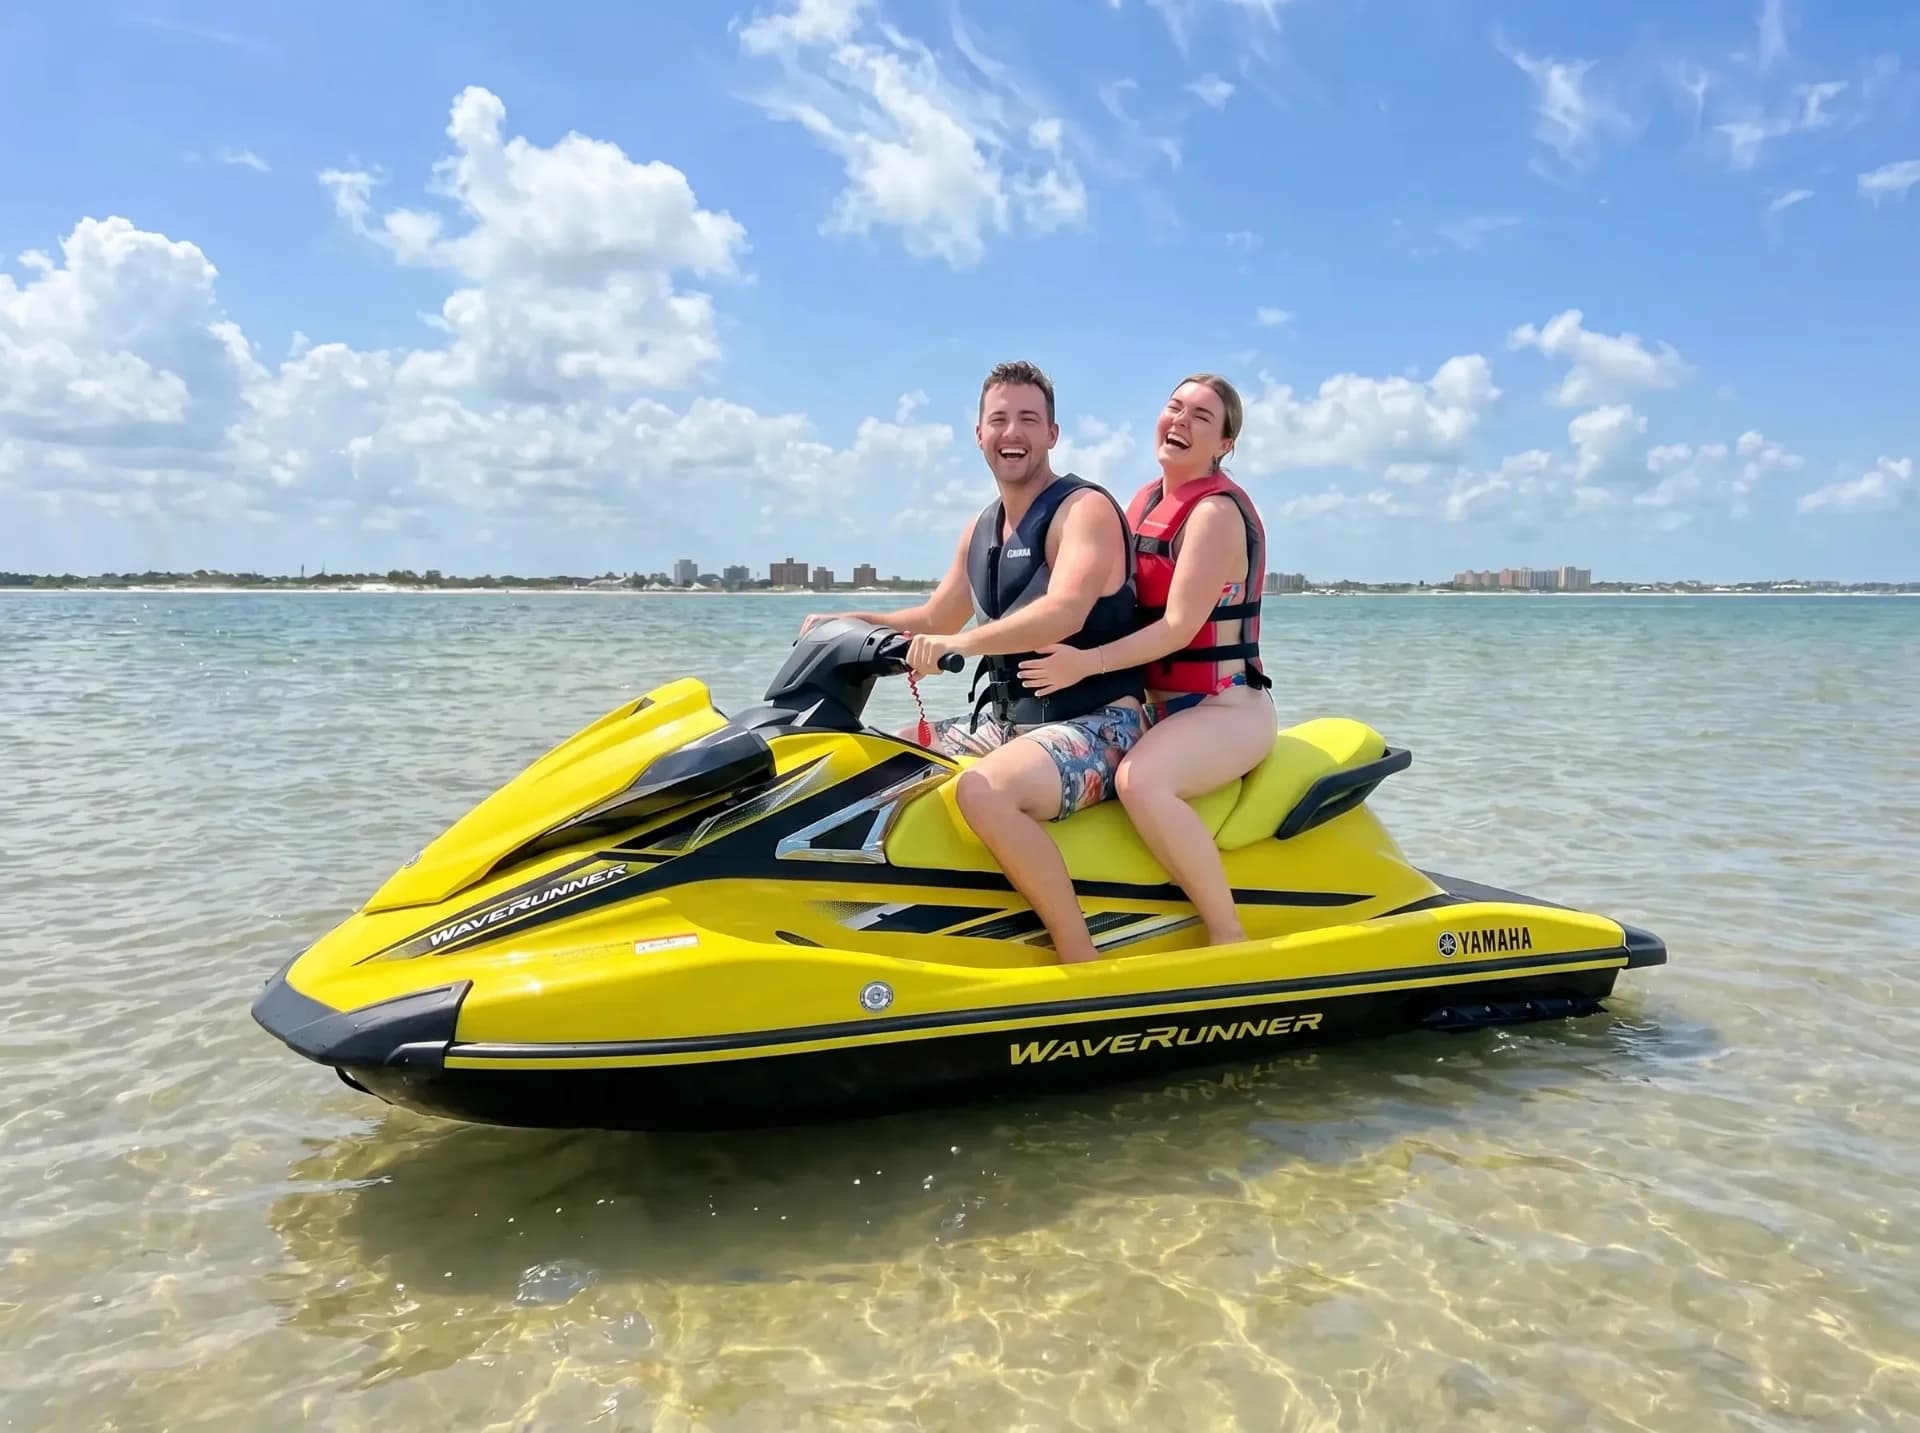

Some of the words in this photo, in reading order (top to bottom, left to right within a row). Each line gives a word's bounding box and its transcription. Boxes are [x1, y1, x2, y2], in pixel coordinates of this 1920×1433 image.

[430, 864, 627, 947] WAVERUNNER
[1458, 926, 1532, 955] YAMAHA
[1010, 1013, 1324, 1065] WAVERUNNER
